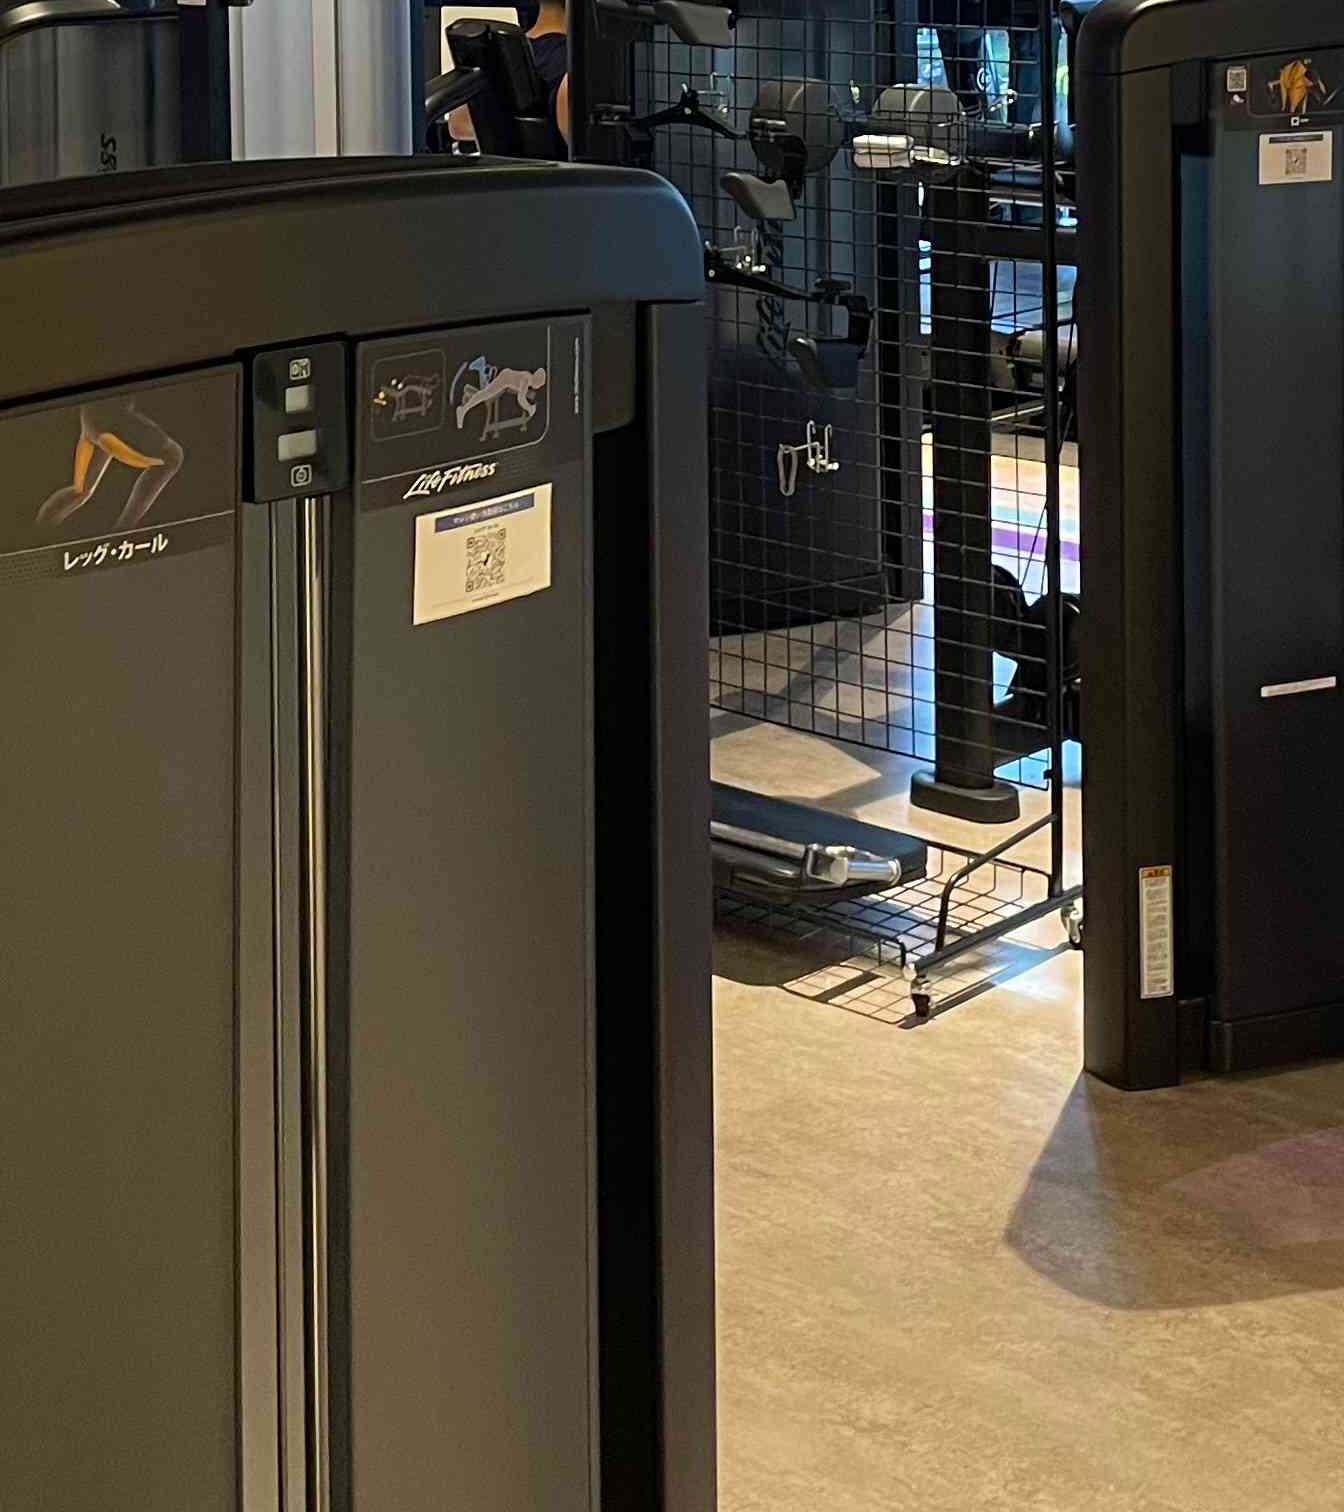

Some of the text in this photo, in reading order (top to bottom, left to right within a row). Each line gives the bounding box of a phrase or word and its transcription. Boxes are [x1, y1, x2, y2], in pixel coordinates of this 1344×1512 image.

[64, 533, 168, 570] レッグ・カール
